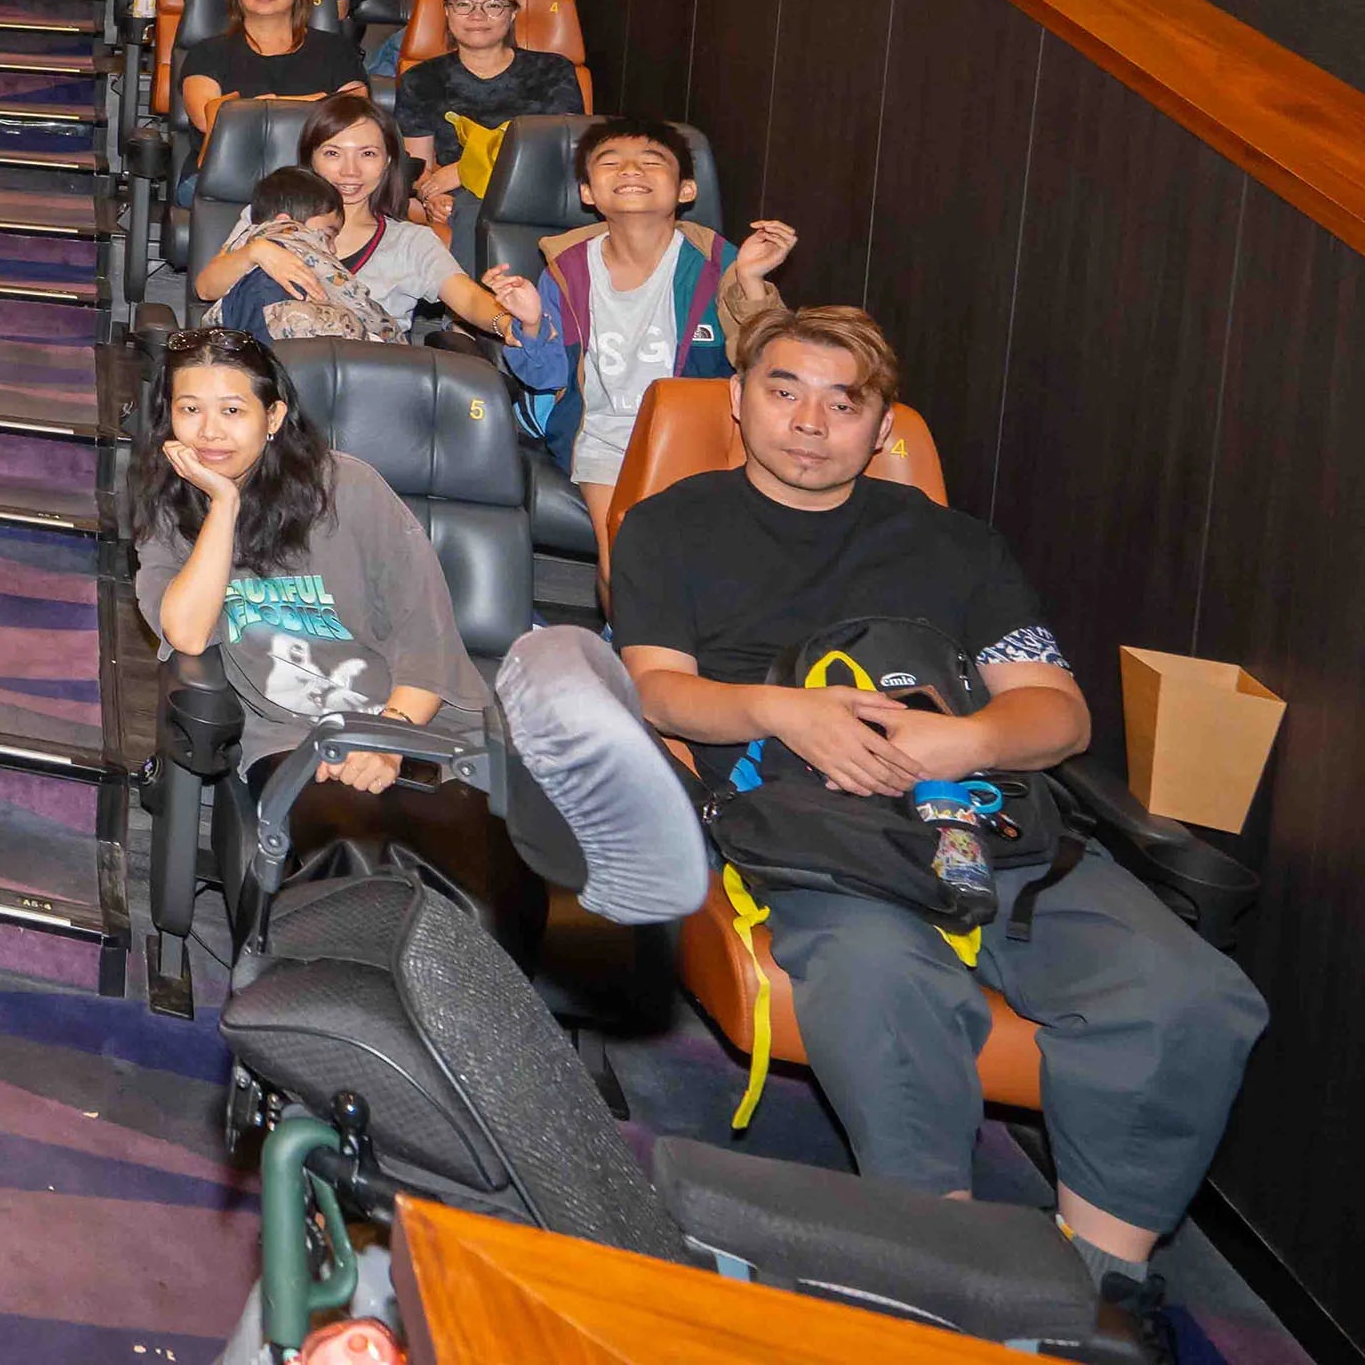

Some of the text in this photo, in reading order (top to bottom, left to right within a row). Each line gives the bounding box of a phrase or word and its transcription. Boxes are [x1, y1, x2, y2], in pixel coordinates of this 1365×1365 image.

[549, 2, 559, 14] 4
[469, 399, 485, 420] 5
[890, 438, 909, 459] 4
[225, 574, 336, 605] AUTIFUL
[880, 672, 917, 687] emis
